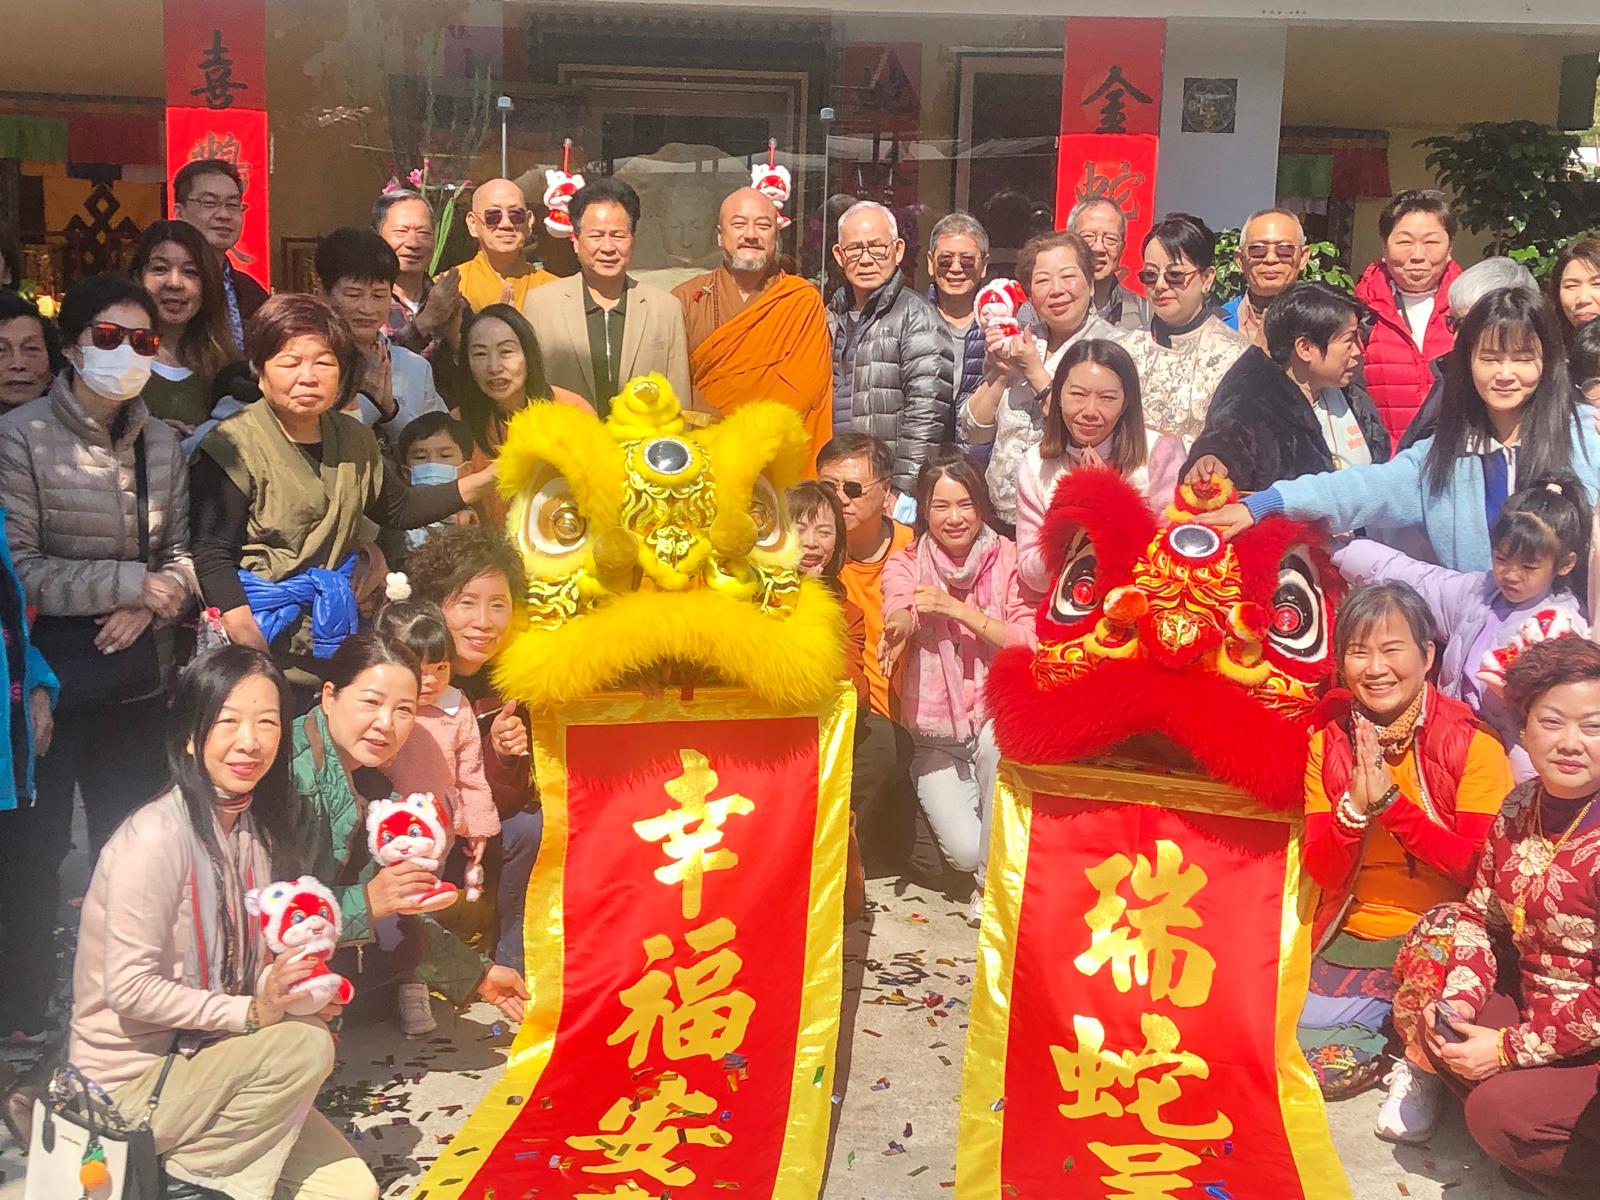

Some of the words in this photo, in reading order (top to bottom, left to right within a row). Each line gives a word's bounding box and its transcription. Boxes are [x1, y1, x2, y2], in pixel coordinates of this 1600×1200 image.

[1076, 65, 1154, 281] 金蛇
[565, 748, 757, 1200] 幸福安
